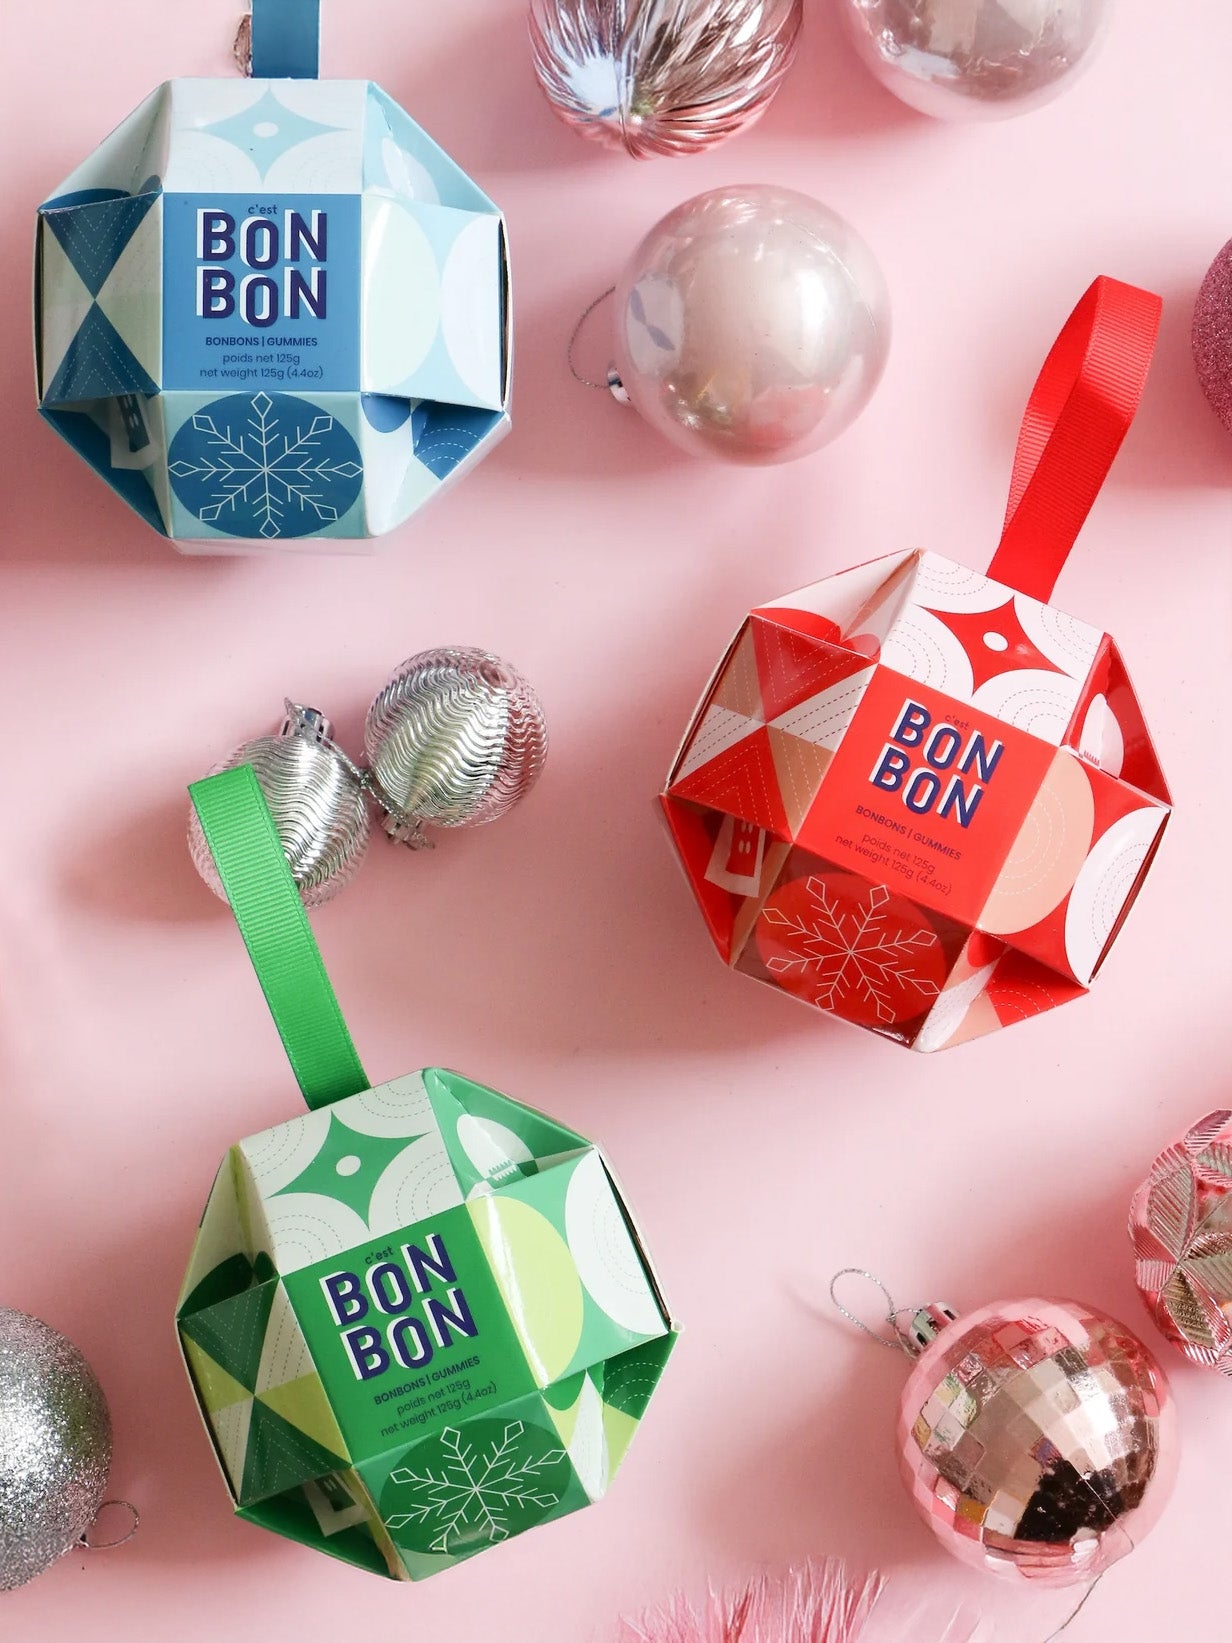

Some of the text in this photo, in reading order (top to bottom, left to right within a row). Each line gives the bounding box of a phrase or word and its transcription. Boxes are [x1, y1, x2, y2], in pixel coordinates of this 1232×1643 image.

[248, 204, 277, 214] c'est
[196, 209, 327, 270] BON
[196, 266, 326, 327] BON
[206, 337, 259, 346] BONBONS
[267, 337, 318, 346] GUMMIES
[223, 354, 300, 365] poids net 125g
[200, 366, 323, 379] net weight 125g (4.4oz)
[889, 698, 1005, 784] BON
[945, 714, 970, 730] c'est
[868, 742, 984, 829] BON
[856, 805, 906, 835] BONBONS
[913, 832, 961, 860] GUMMIES
[862, 833, 935, 874] poids net 125g
[835, 835, 952, 896] net weight 125g (4.4oz)
[319, 1233, 457, 1326] BON
[365, 1246, 393, 1265] c'est
[340, 1288, 478, 1381] BON
[374, 1379, 425, 1405] BONBONS
[432, 1356, 480, 1382] GUMMIES
[397, 1378, 471, 1417] poids net 125g
[381, 1382, 497, 1437] net weight 125g (4.4oz)
